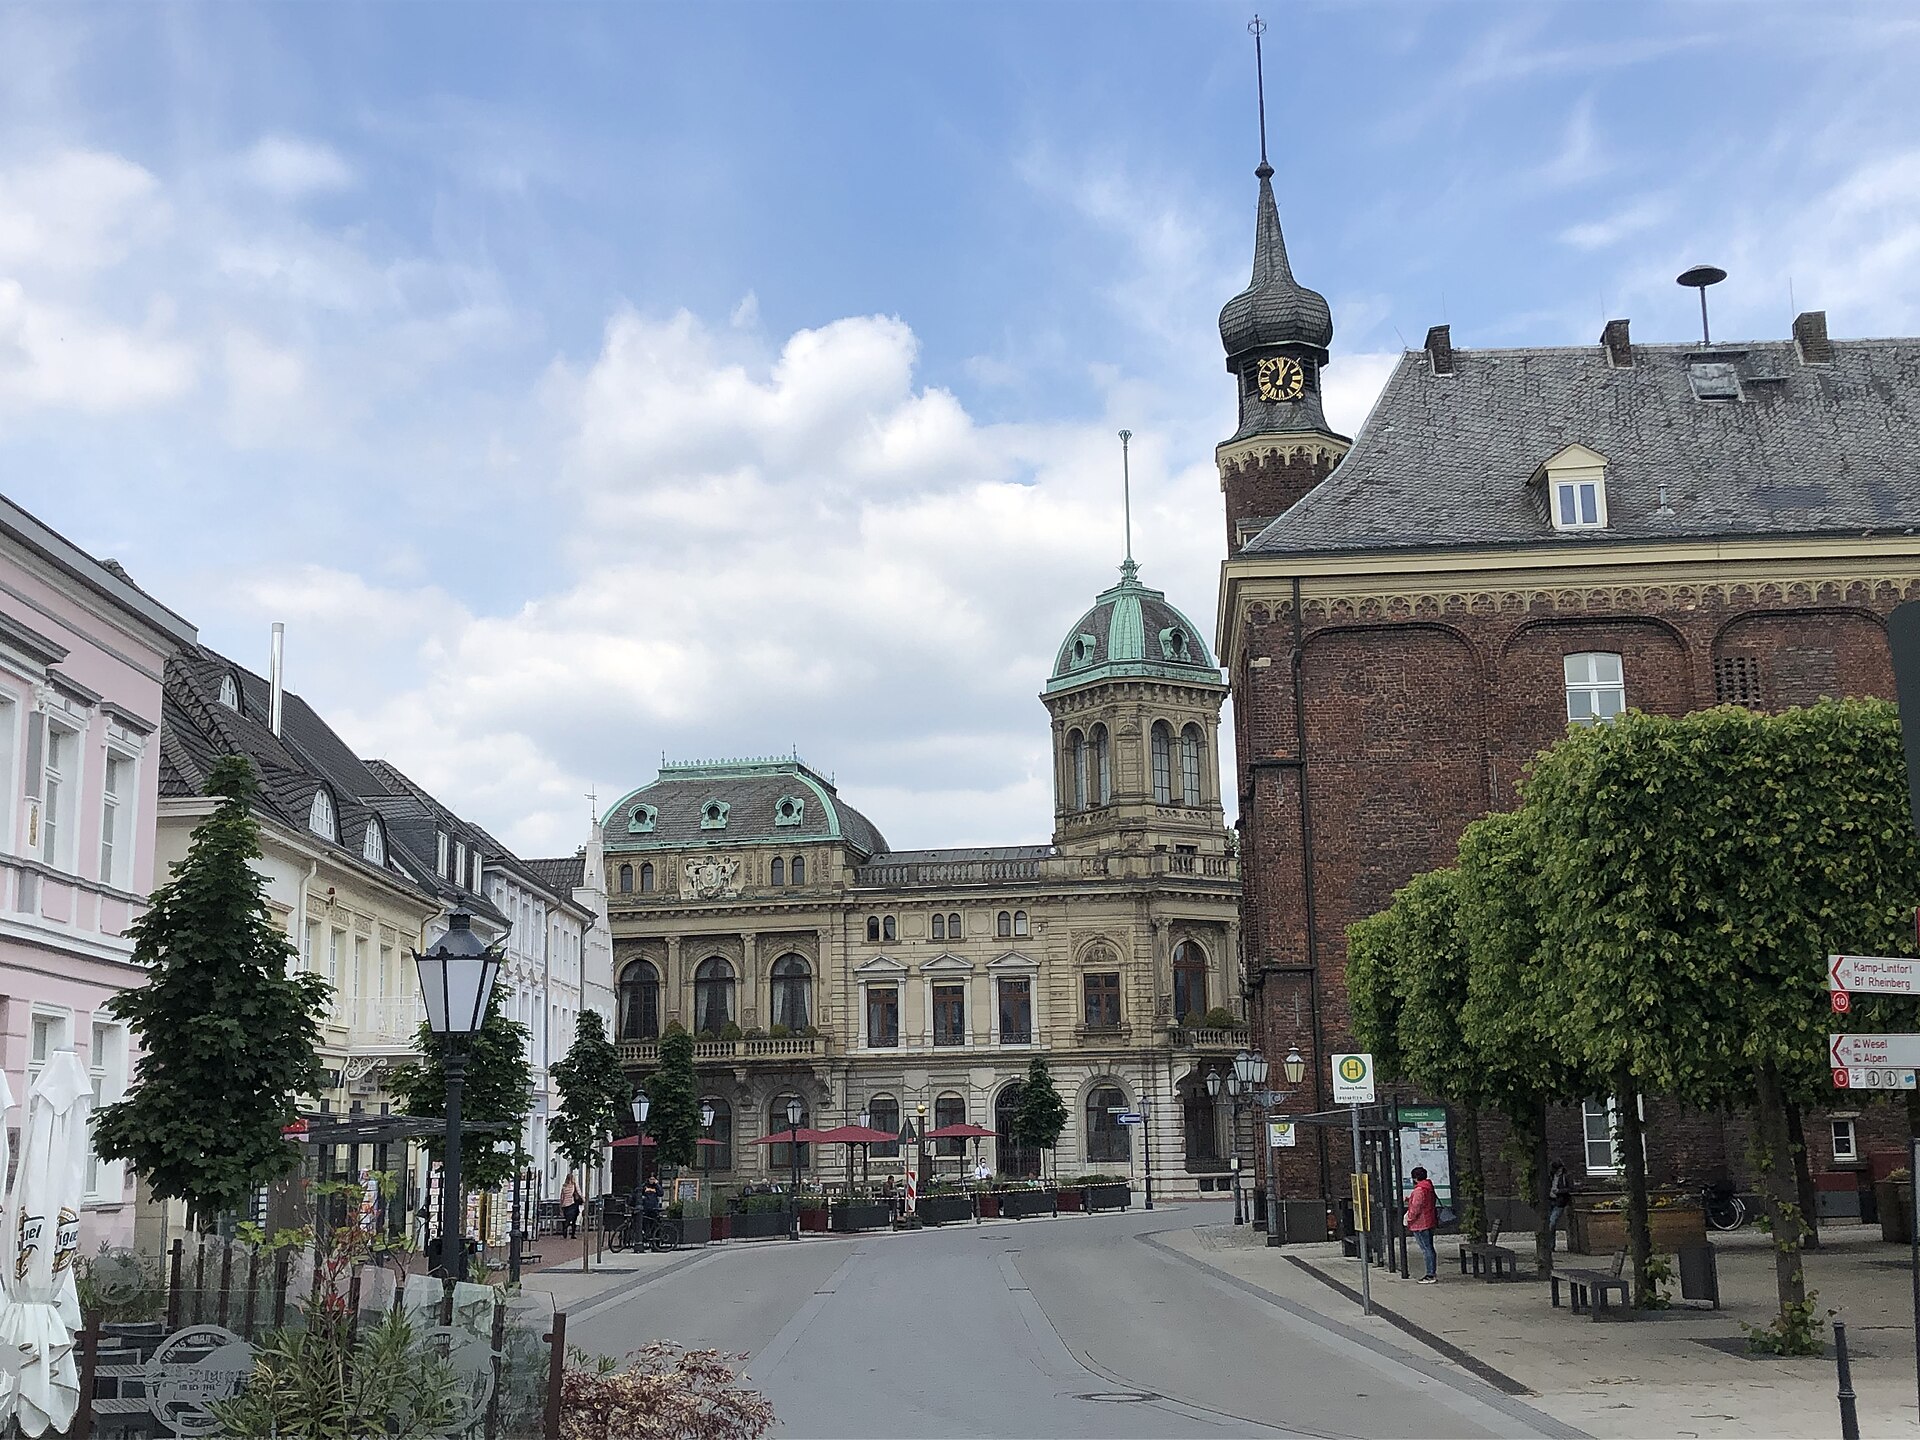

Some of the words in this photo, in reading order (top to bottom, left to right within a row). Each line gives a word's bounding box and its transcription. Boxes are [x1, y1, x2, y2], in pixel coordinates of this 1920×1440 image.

[1853, 961, 1912, 974] Kamp-Lintfort
[1868, 976, 1911, 990] Rheinberg
[1836, 997, 1846, 1006] 10
[1862, 1039, 1888, 1049] Wesel
[1863, 1053, 1888, 1064] Alpen
[1346, 1061, 1359, 1077] H
